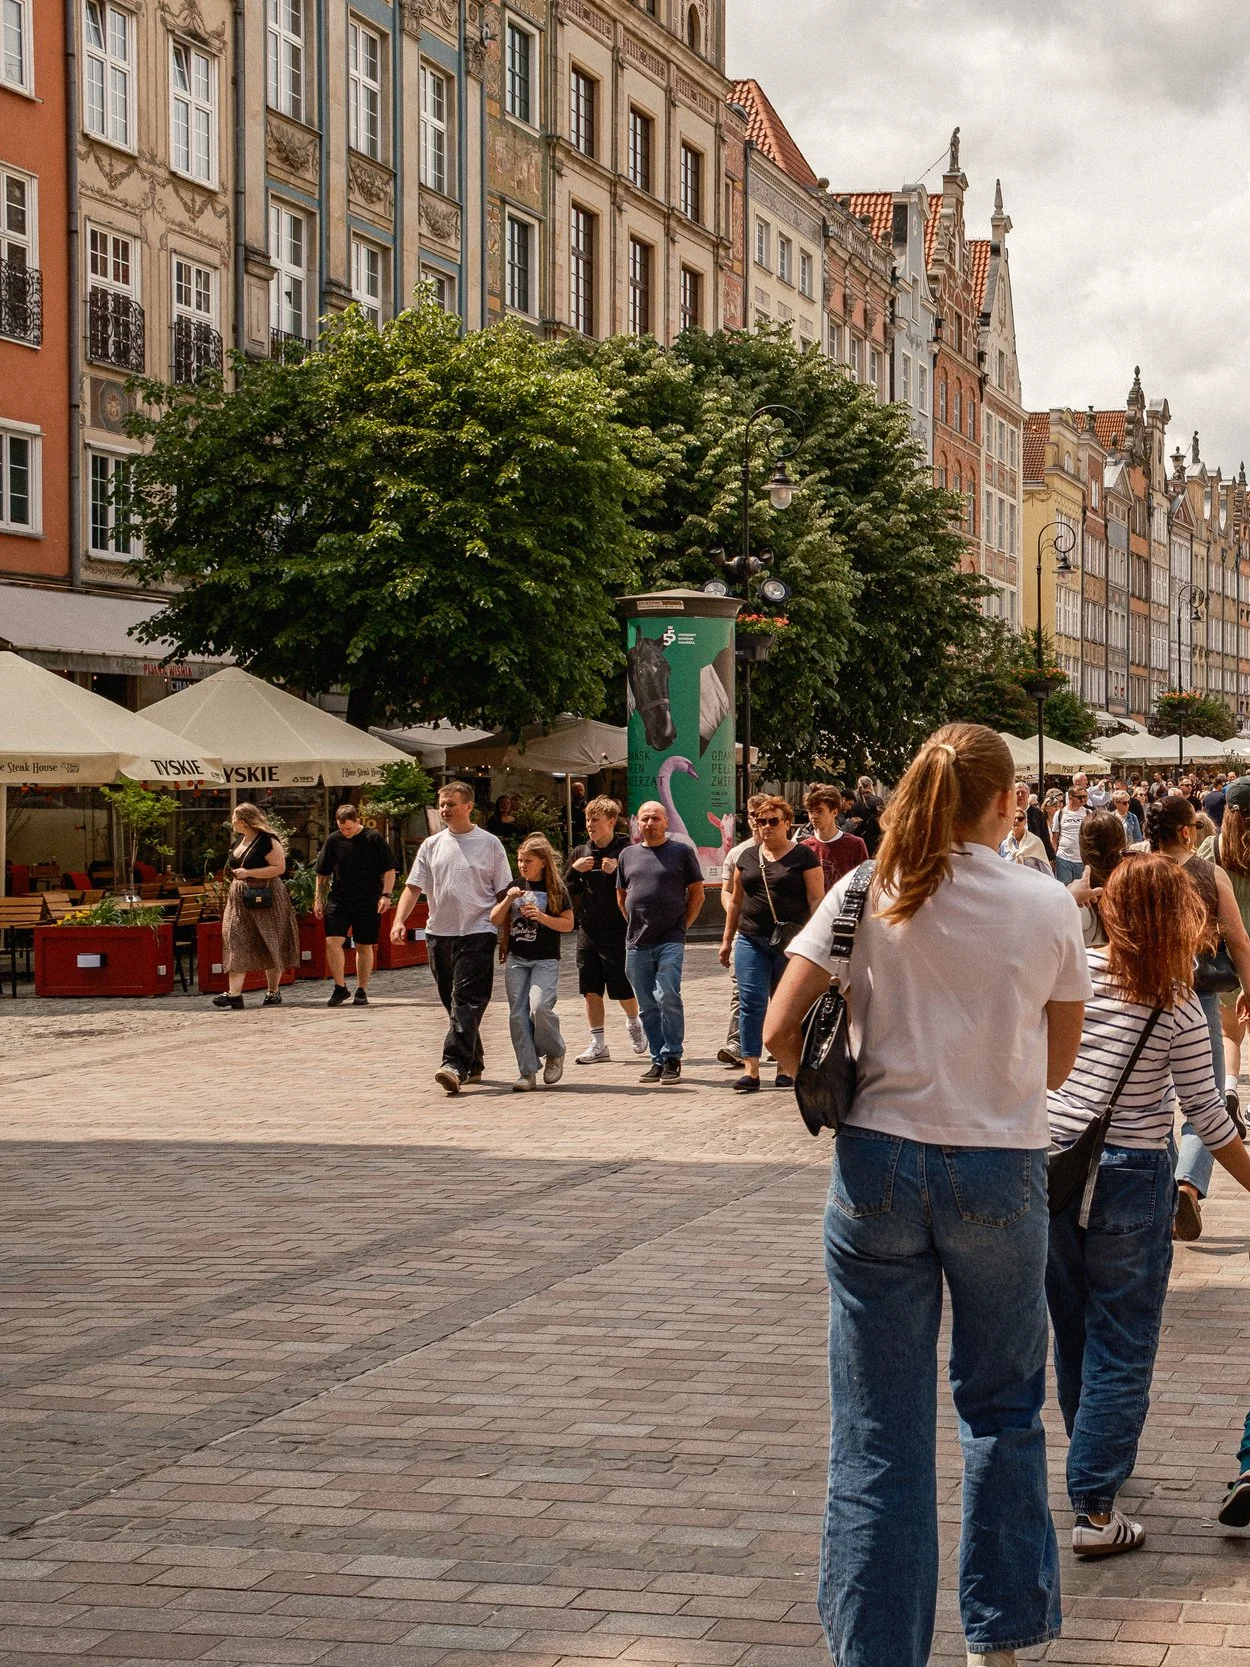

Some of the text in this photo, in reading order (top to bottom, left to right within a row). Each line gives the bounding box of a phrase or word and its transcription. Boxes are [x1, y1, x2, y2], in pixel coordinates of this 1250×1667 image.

[7, 761, 30, 774] Steak
[32, 762, 58, 774] House
[150, 759, 204, 776] TYSKIE
[223, 765, 280, 783] YSKIE
